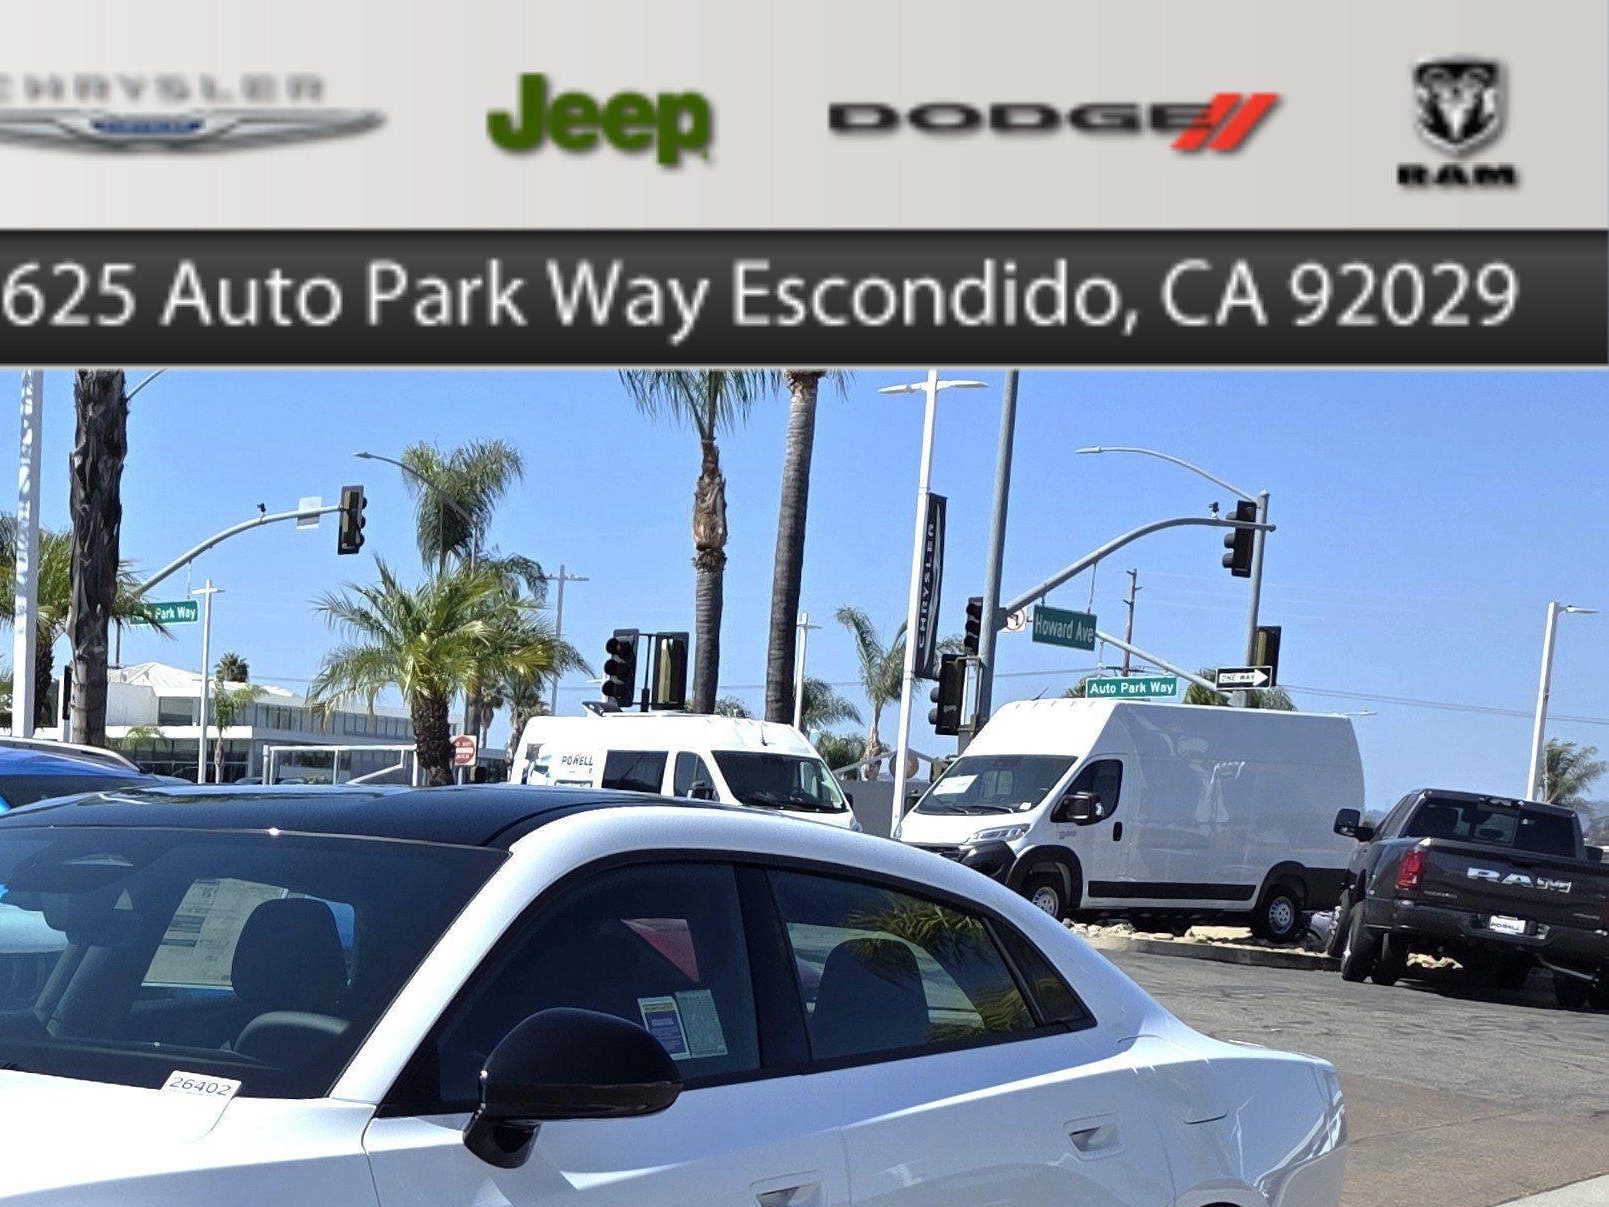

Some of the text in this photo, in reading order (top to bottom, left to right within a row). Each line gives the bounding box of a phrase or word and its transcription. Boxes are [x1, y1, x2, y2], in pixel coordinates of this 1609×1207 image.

[177, 606, 196, 620] Way
[1034, 612, 1095, 643] Howard Ave
[1090, 681, 1174, 694] Auto Park Way
[1467, 867, 1572, 893] RAM
[170, 1077, 232, 1096] 26402
